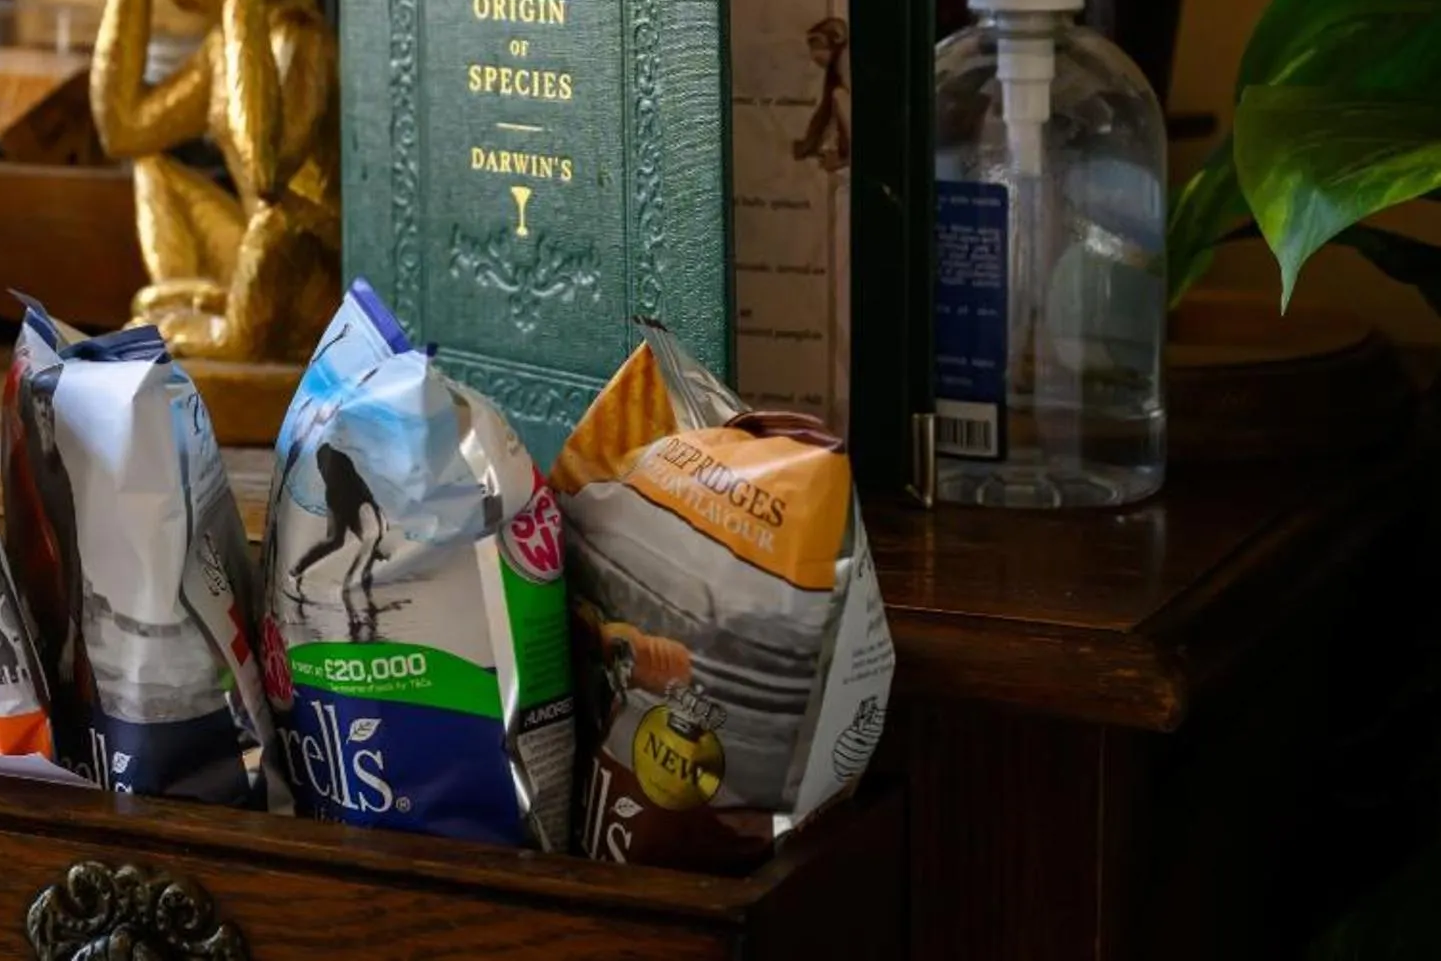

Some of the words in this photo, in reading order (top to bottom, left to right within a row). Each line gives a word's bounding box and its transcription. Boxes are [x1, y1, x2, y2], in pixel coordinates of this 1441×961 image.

[509, 40, 529, 57] OF
[468, 64, 573, 100] SPECIES
[471, 147, 573, 183] DARWIN'S
[690, 455, 786, 528] RIDGES
[324, 652, 428, 683] £20,000
[643, 731, 706, 786] NEW
